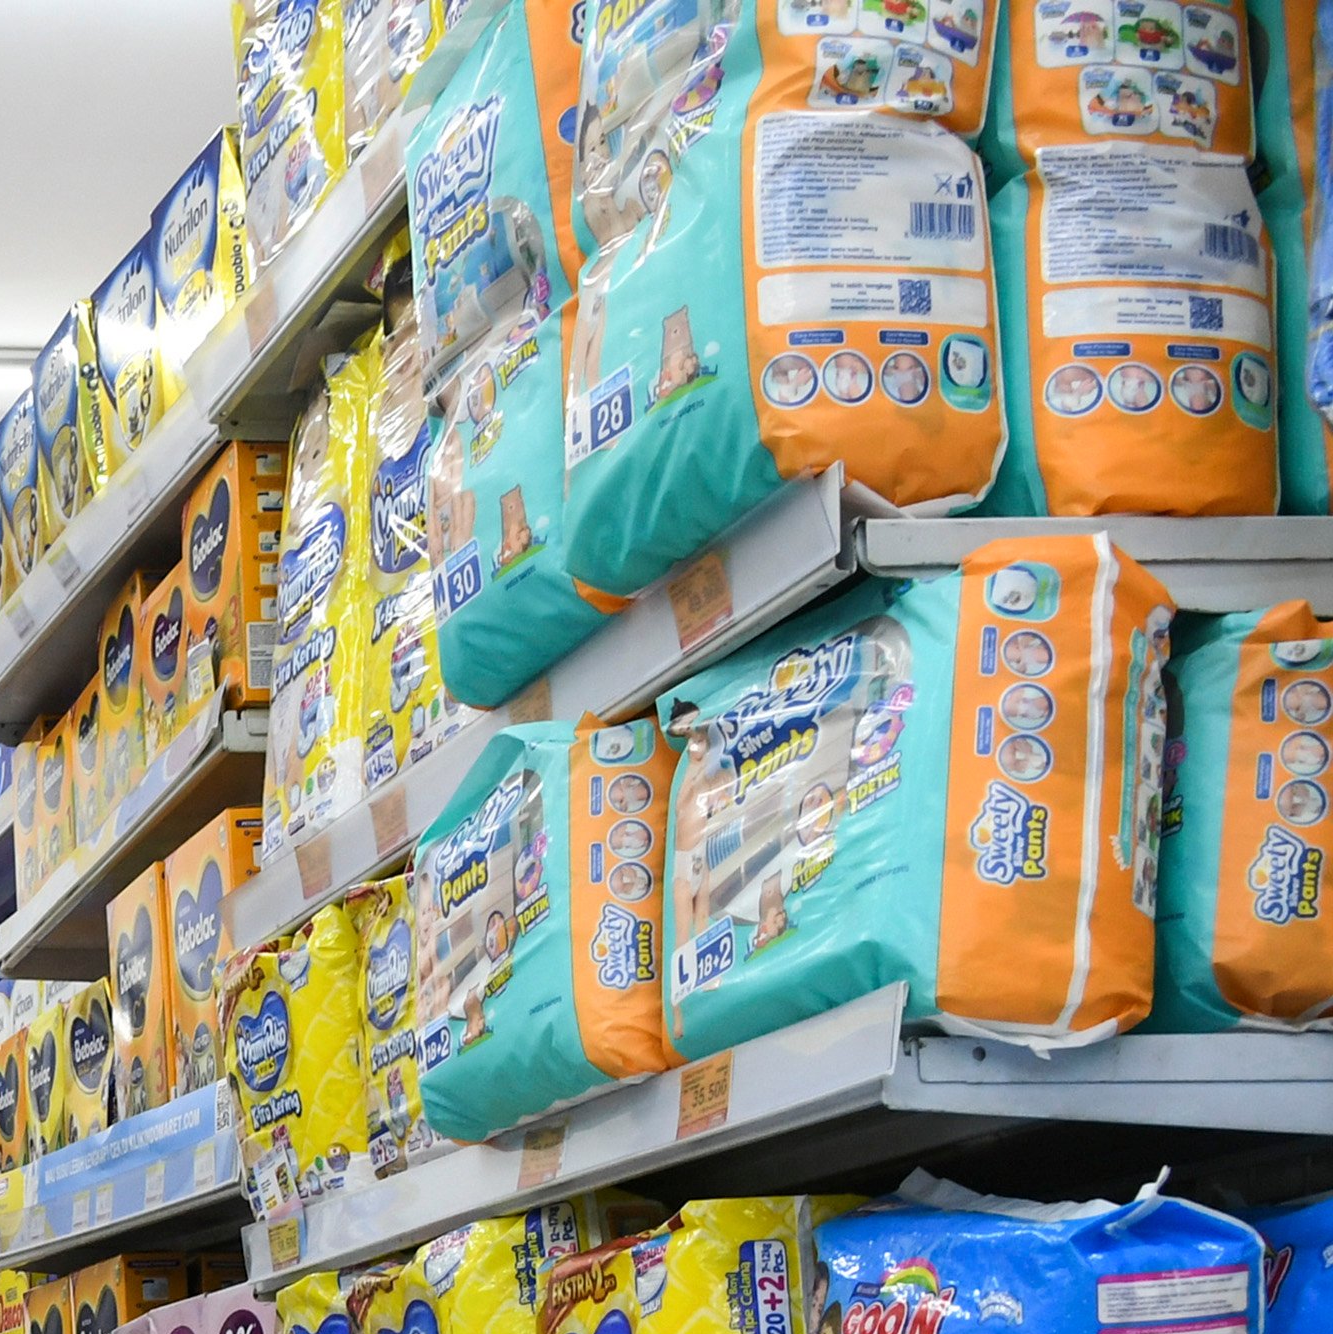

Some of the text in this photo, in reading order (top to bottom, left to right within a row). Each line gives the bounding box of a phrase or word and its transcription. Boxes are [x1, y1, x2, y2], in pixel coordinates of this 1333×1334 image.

[416, 112, 499, 212] Sweety
[164, 196, 209, 262] Nutrilon
[571, 409, 583, 446] L
[596, 398, 623, 440] 28
[191, 522, 223, 573] Bebelac
[452, 566, 476, 602] 30
[154, 619, 180, 657] Bebelac
[294, 628, 335, 674] Kering
[737, 730, 774, 761] Silver
[738, 725, 818, 805] Pants
[856, 764, 901, 803] DETIK
[981, 782, 1023, 882] Sweety
[1022, 806, 1048, 877] Pants
[440, 857, 488, 916] Pants
[1255, 826, 1303, 921] Sweety
[1296, 847, 1322, 918] Pants
[178, 911, 217, 954] Bebelac
[597, 905, 634, 988] Sweety
[634, 921, 654, 981] Pants
[118, 957, 147, 995] Bebelac
[676, 951, 691, 985] L
[74, 1032, 105, 1063] Bebelac
[691, 1079, 729, 1103] 35.500
[551, 1261, 606, 1307] EKSTRA 2
[739, 1261, 754, 1306] Celana
